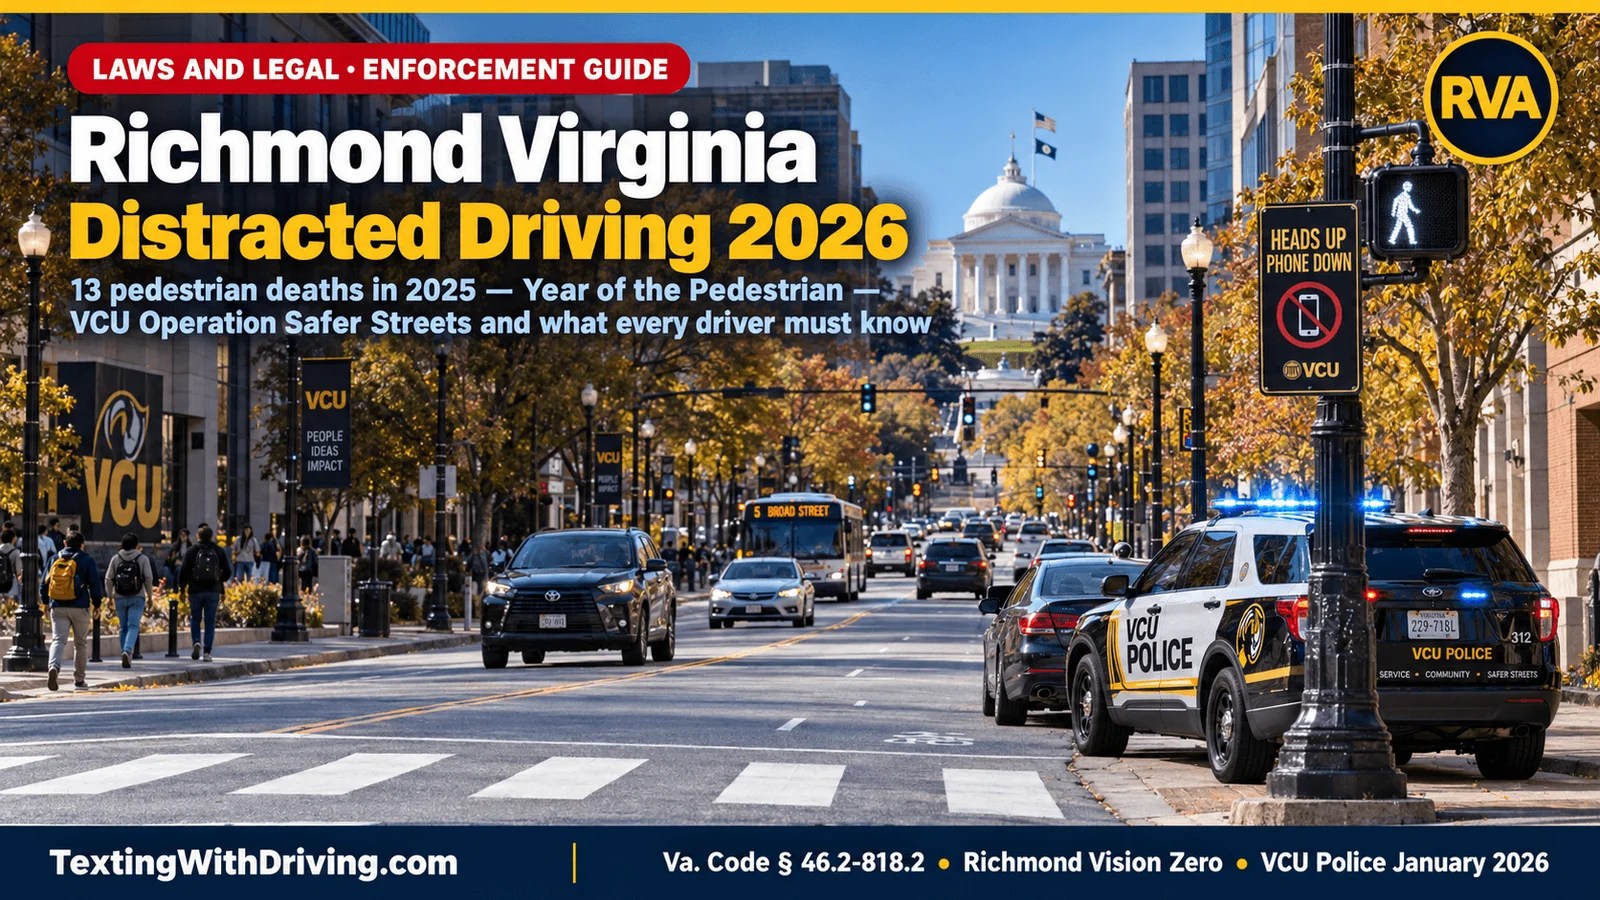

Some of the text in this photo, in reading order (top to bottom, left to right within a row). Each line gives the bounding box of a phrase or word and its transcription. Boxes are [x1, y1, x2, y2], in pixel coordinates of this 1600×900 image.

[1271, 228, 1346, 250] HEADS UP
[1267, 252, 1352, 273] PHONE DOWN
[1302, 361, 1340, 378] VCU
[305, 390, 347, 410] VCU
[306, 430, 343, 442] PEOPLE
[310, 446, 339, 457] IDEAS
[596, 451, 620, 464] VCU
[307, 460, 343, 472] IMPACT
[83, 456, 162, 529] VCU
[754, 505, 830, 518] 5 BROAD STREET
[1126, 615, 1159, 643] VCU
[1411, 620, 1456, 632] 229-718L
[1511, 632, 1532, 644] 312
[1127, 637, 1193, 674] POLICE
[1412, 647, 1493, 660] VCU POLICE
[1379, 670, 1539, 679] SERVICE COMMUNITY SAFER STREETS
